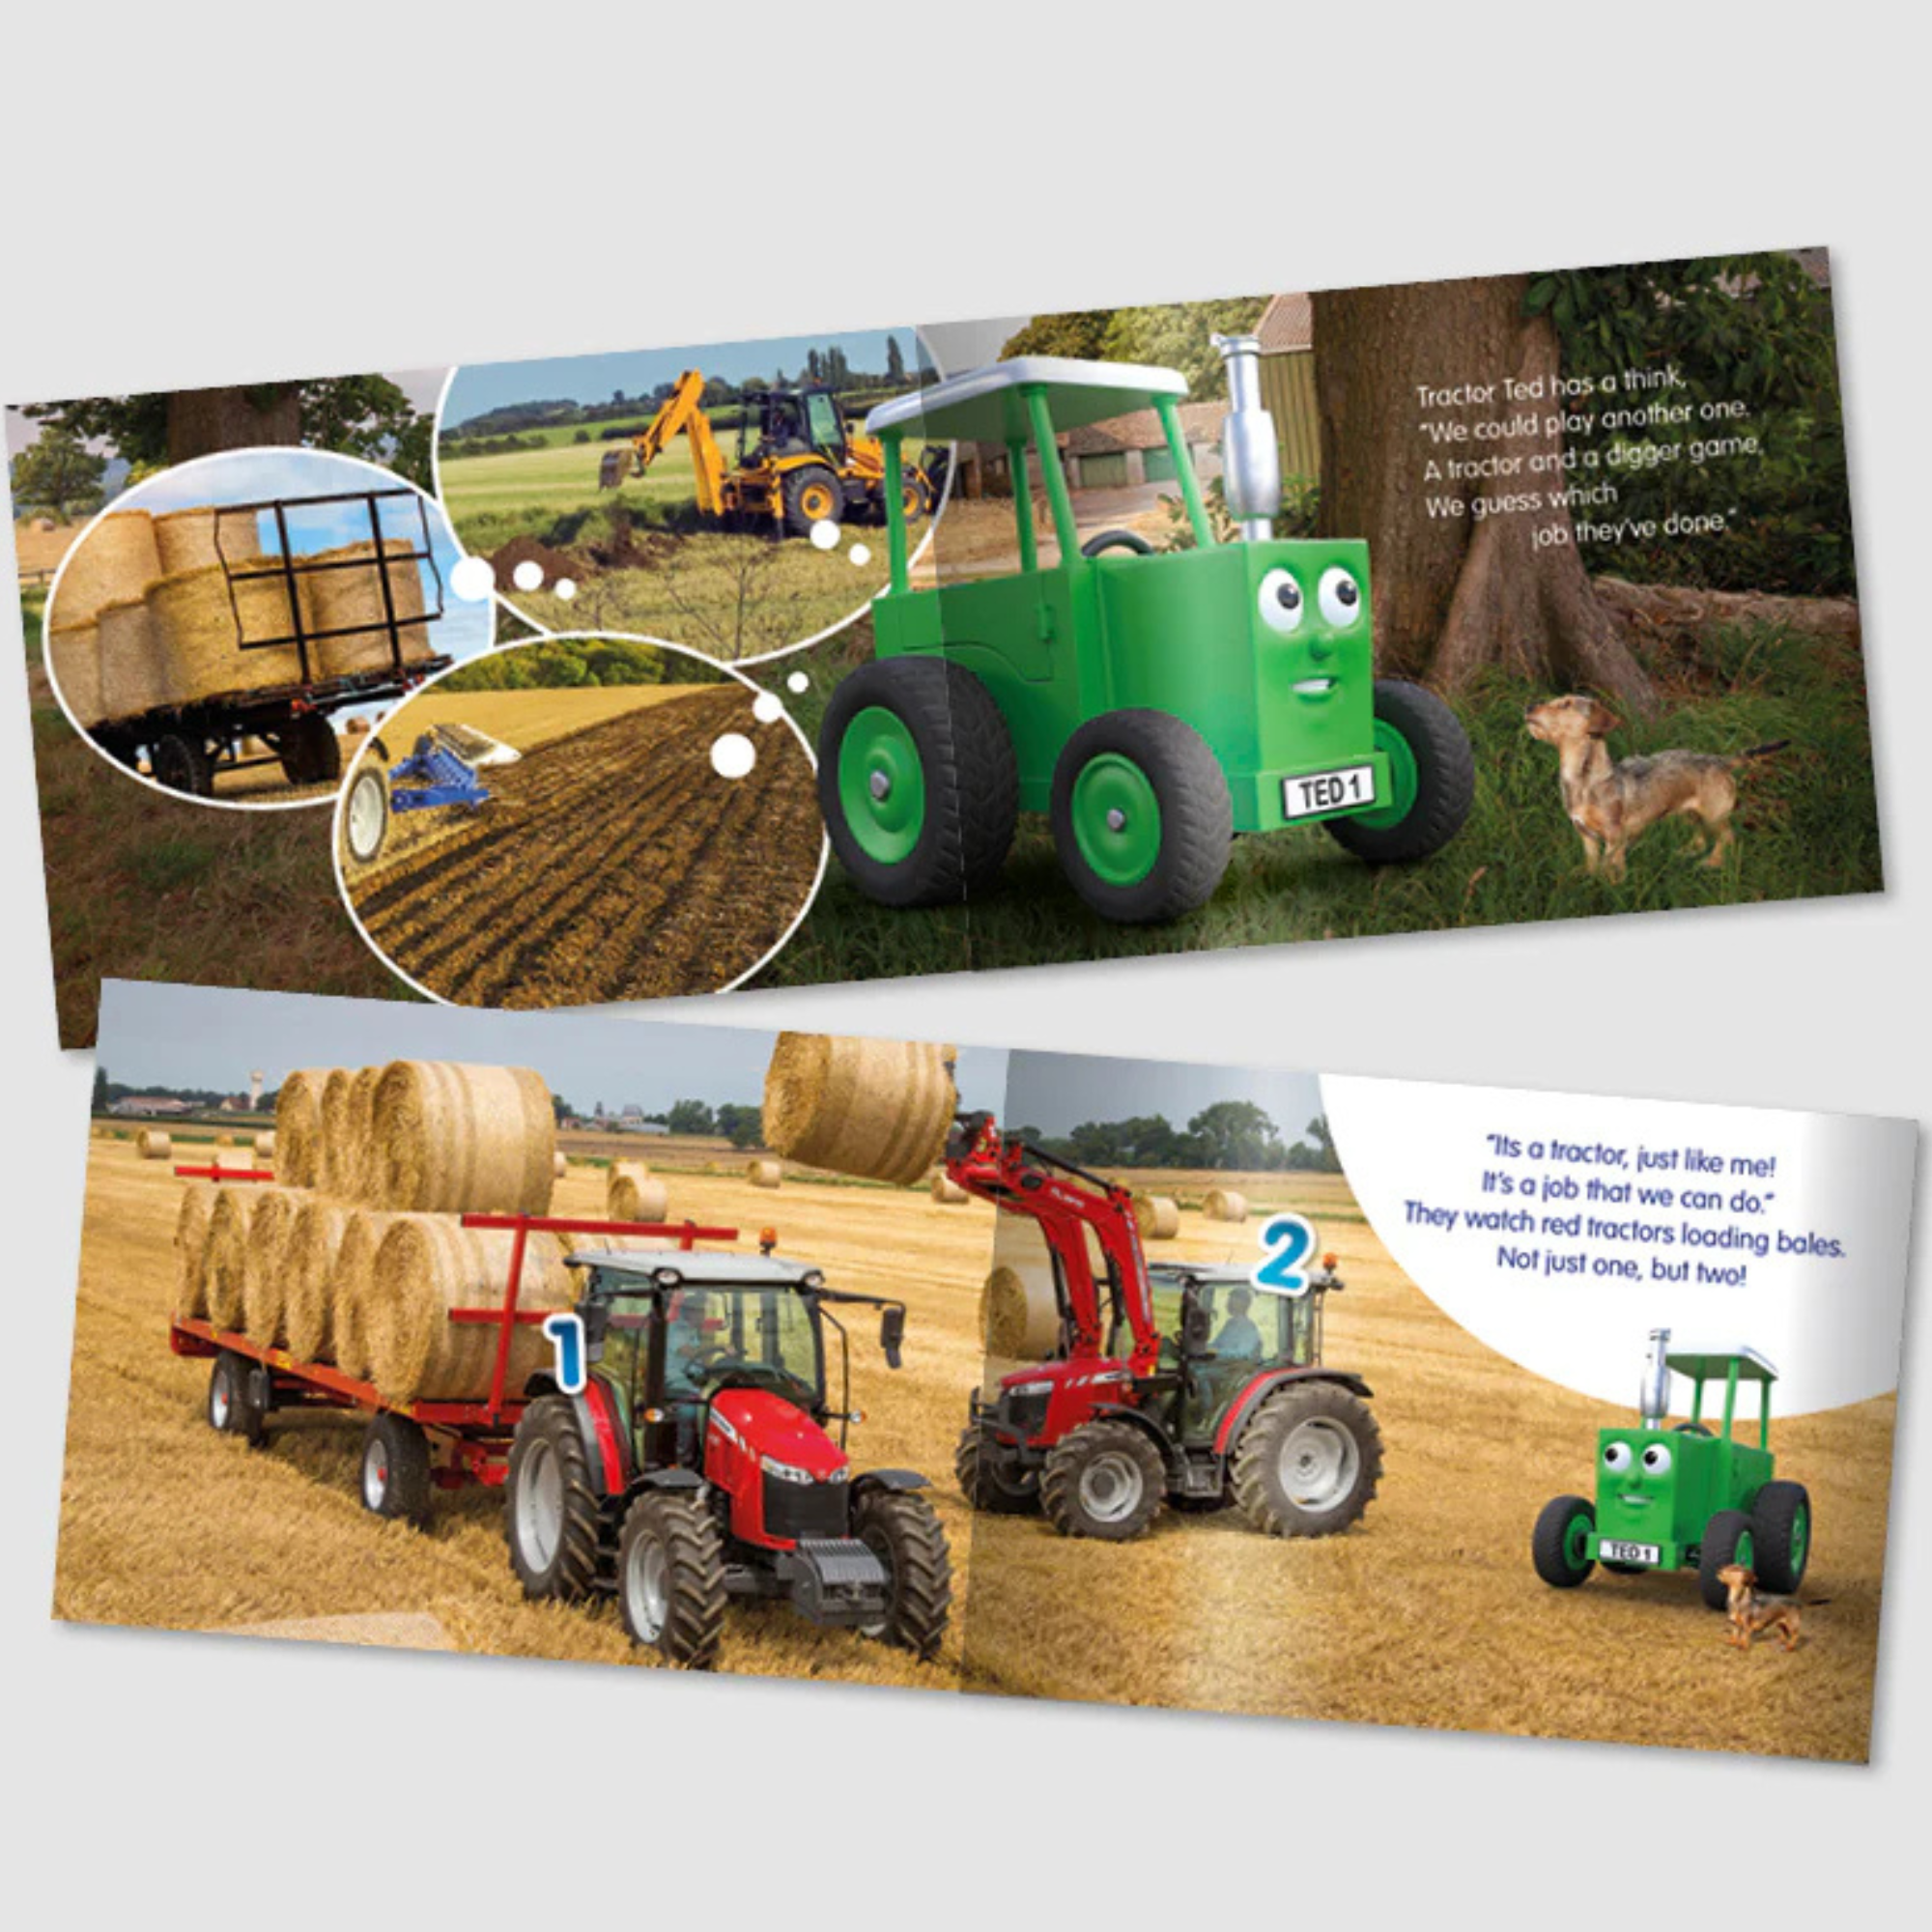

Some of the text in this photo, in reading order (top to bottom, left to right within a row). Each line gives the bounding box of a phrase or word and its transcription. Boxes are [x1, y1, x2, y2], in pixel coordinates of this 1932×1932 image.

[1417, 384, 1495, 408] Tractor
[1503, 378, 1543, 401] Ted
[1551, 374, 1593, 398] has
[1602, 375, 1617, 392] a
[1474, 412, 1538, 439] could
[1547, 410, 1594, 439] play
[1602, 400, 1691, 429] another
[1424, 460, 1441, 481] A
[1449, 456, 1521, 480] tractor
[1529, 447, 1576, 472] and
[1583, 451, 1599, 469] a
[1606, 439, 1681, 470] digger
[1426, 481, 1618, 521] We guess which
[1531, 522, 1568, 552] job
[1576, 518, 1657, 545] they've
[1298, 774, 1360, 809] TED 1
[1527, 1143, 1544, 1160] a
[1635, 1146, 1679, 1174] just
[1684, 1148, 1724, 1174] like
[1730, 1155, 1776, 1179] me!
[1482, 1171, 1514, 1195] It's
[1520, 1179, 1536, 1197] a
[1541, 1174, 1579, 1203] job
[1586, 1179, 1633, 1205] that
[1638, 1187, 1673, 1208] we
[1681, 1190, 1722, 1210] can
[1405, 1200, 1459, 1232] They
[1464, 1205, 1535, 1233] watch
[1542, 1214, 1580, 1237] red
[1587, 1217, 1675, 1244] tractors
[1681, 1221, 1769, 1257] loading
[1257, 1220, 1309, 1291] 2
[1496, 1245, 1540, 1270] Not
[1545, 1249, 1586, 1276] just
[1651, 1257, 1690, 1282] but
[1697, 1261, 1747, 1287] two!
[548, 1320, 581, 1388] 1
